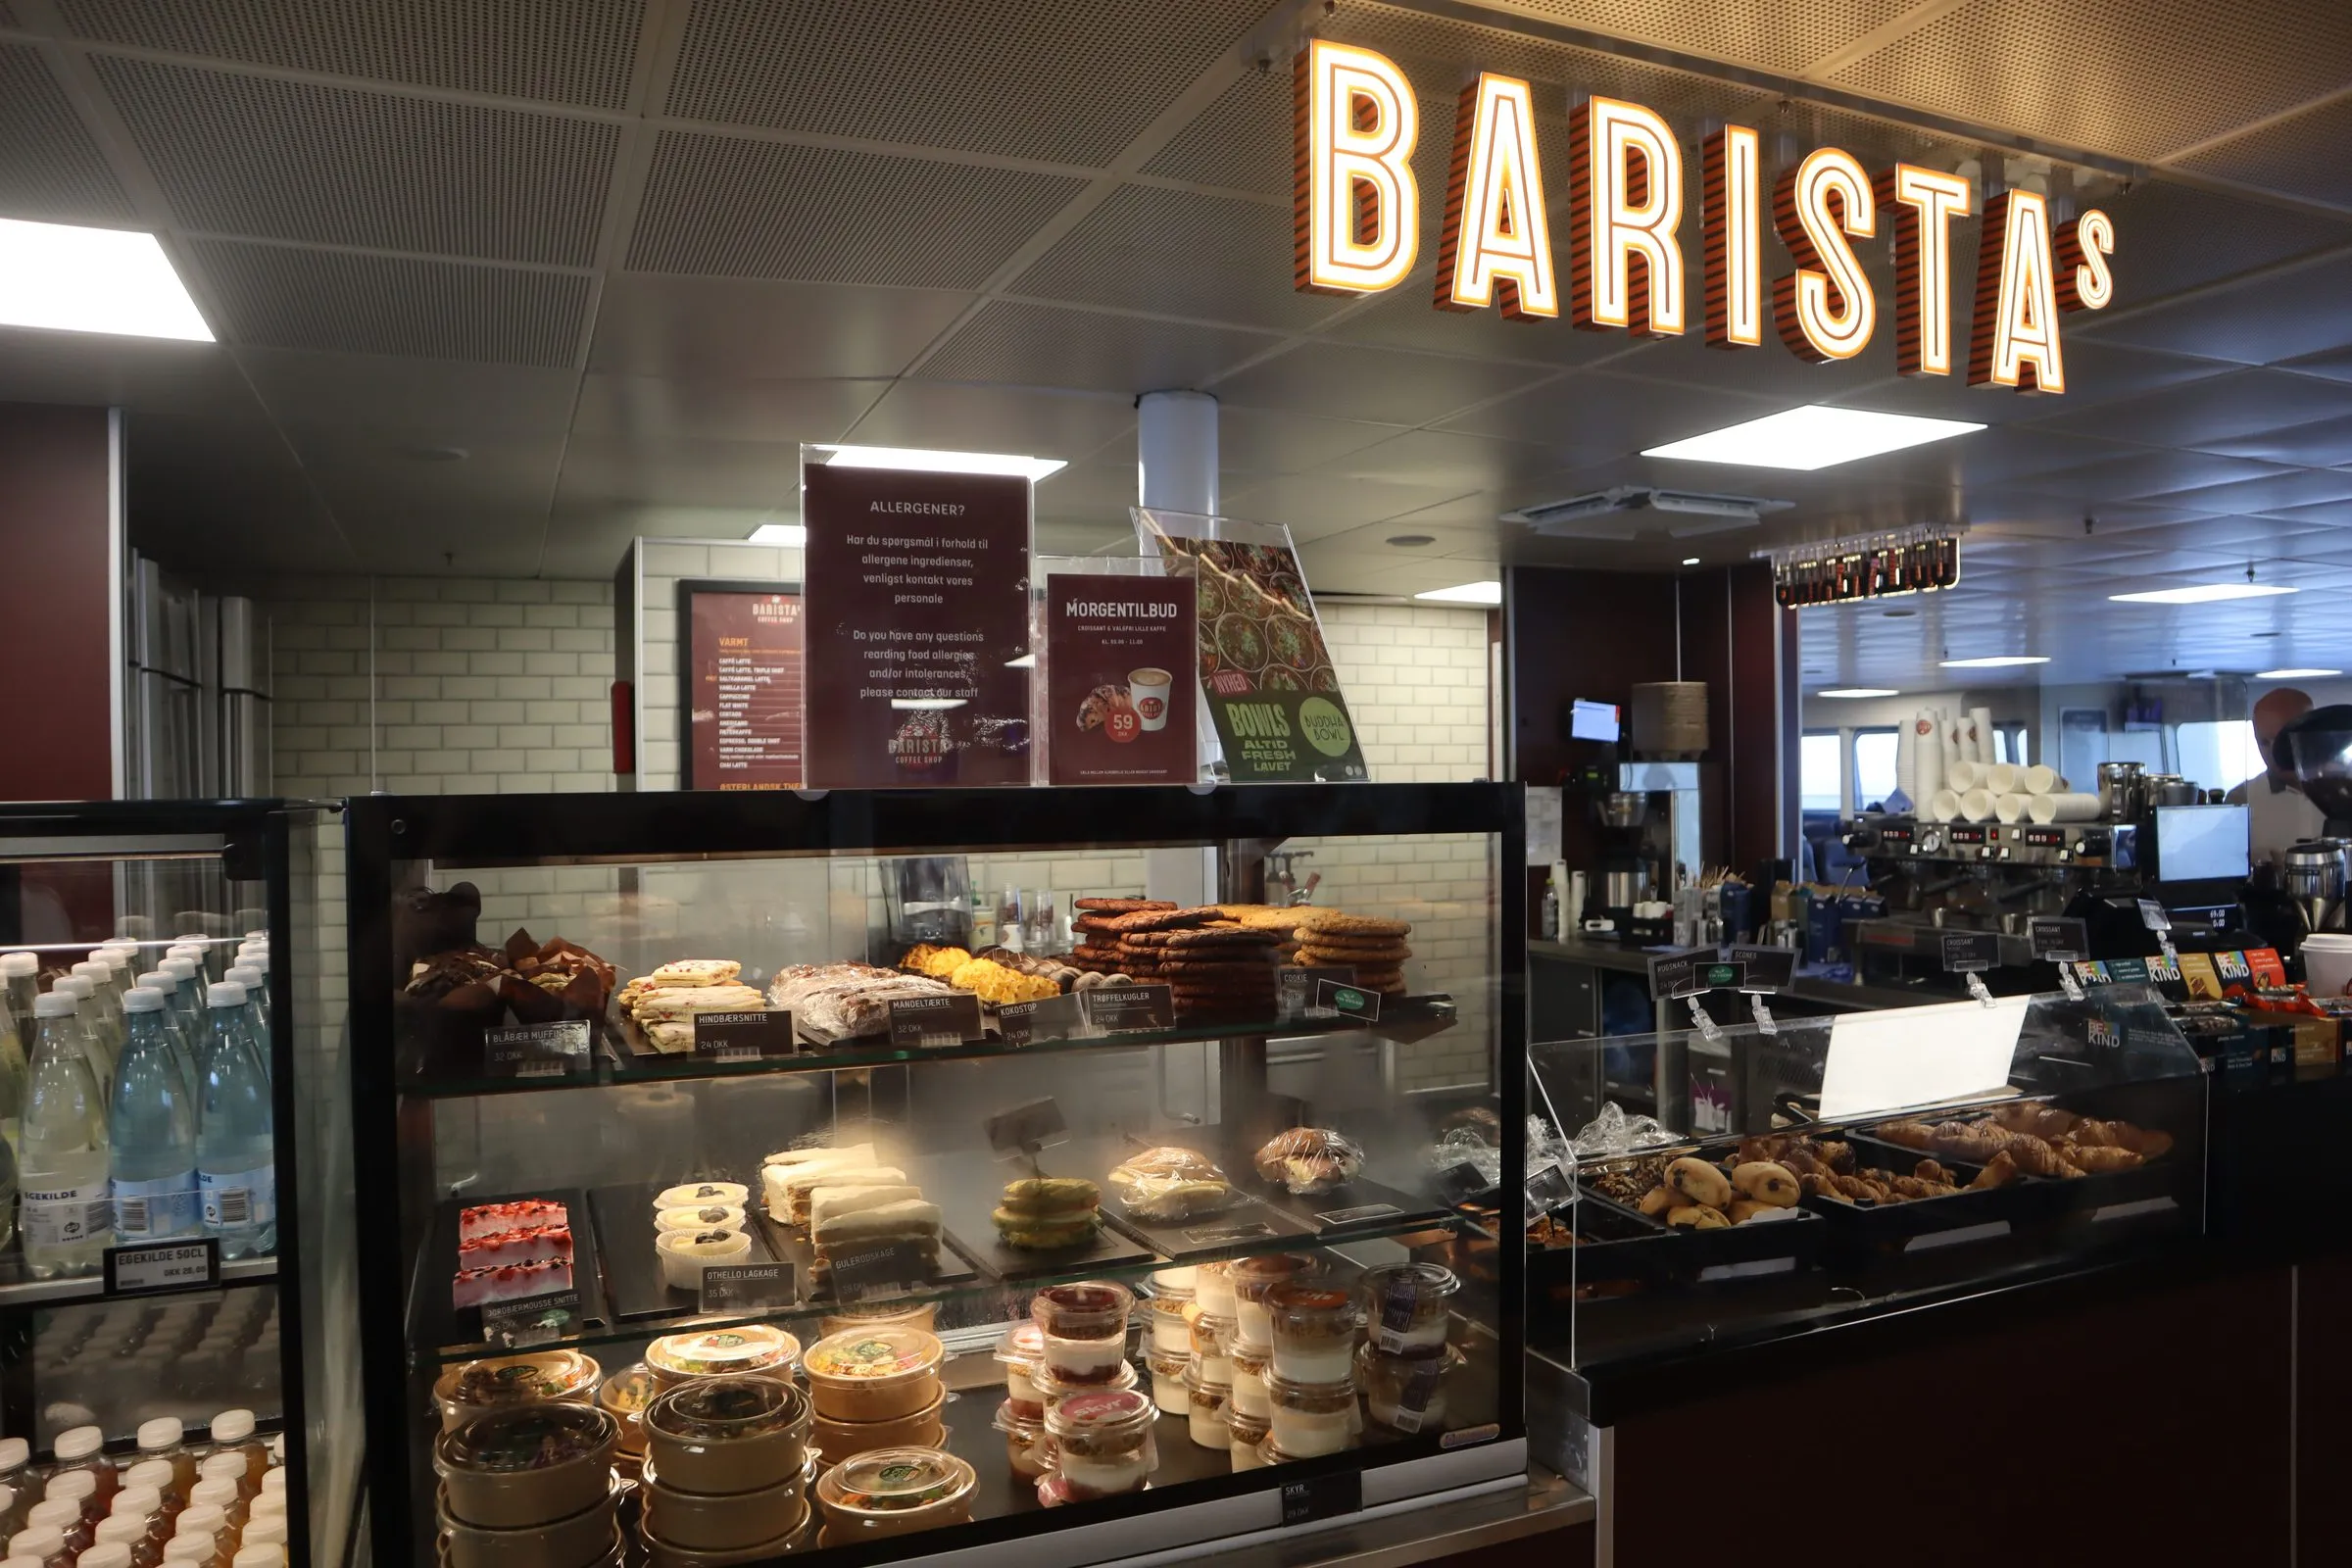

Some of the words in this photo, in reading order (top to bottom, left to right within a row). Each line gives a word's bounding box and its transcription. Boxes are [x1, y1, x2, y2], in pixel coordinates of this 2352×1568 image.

[870, 501, 965, 515] ALLERGENER?
[847, 534, 864, 545] Har
[867, 535, 880, 546] du
[882, 537, 934, 549] spørgsmål
[942, 538, 976, 549] forhold
[978, 539, 989, 550] til
[862, 554, 908, 567] allergene
[910, 555, 974, 568] ingredienser,
[863, 572, 904, 586] venligst
[906, 573, 944, 585] kontakt
[895, 593, 944, 605] personale
[1066, 601, 1178, 618] MORGENTILBUD
[718, 637, 750, 647] VARMT
[853, 630, 866, 640] Do
[869, 632, 887, 642] you
[889, 630, 913, 642] have
[915, 633, 934, 643] any
[936, 632, 984, 643] questions
[864, 649, 906, 662] rearding
[908, 650, 930, 660] food
[932, 650, 974, 662] allergies
[869, 668, 903, 678] and/or
[1214, 673, 1248, 694] NYHED
[860, 687, 894, 699] please
[896, 688, 935, 698] contact
[936, 689, 952, 698] our
[955, 688, 979, 698] staff
[1113, 714, 1134, 730] 59
[1225, 703, 1292, 737] BOWLS
[1304, 715, 1345, 728] BUDDHA
[1313, 727, 1346, 741] BOWL
[1244, 740, 1289, 749] ALTID
[1241, 750, 1297, 760] FRESH
[1253, 761, 1292, 771] LAVET
[1735, 951, 1758, 959] SCONES
[1285, 973, 1308, 982] COOKIE
[2150, 967, 2181, 982] KIND
[2221, 963, 2250, 979] KIND
[893, 998, 952, 1009] MANDELTÆRTE
[1093, 992, 1151, 1003] TRØFFELKUGLER
[1000, 1003, 1038, 1016] KOKOSTOP
[699, 1013, 767, 1024] HINDBÆRSNITTE
[493, 1031, 529, 1043] BLÅBÆR
[530, 1028, 563, 1040] MUFFIN
[2088, 1033, 2121, 1048] KIND
[701, 1041, 712, 1050] 24
[713, 1039, 729, 1049] DKK
[119, 1250, 173, 1265] EGEKILDE
[176, 1248, 205, 1260] 50CL
[836, 1247, 896, 1269] GULERODSKAGE
[707, 1270, 742, 1280] OTHELLO
[743, 1268, 779, 1278] LAGKAGE
[553, 1294, 579, 1304] SNITTE
[1285, 1484, 1304, 1495] SKYR
